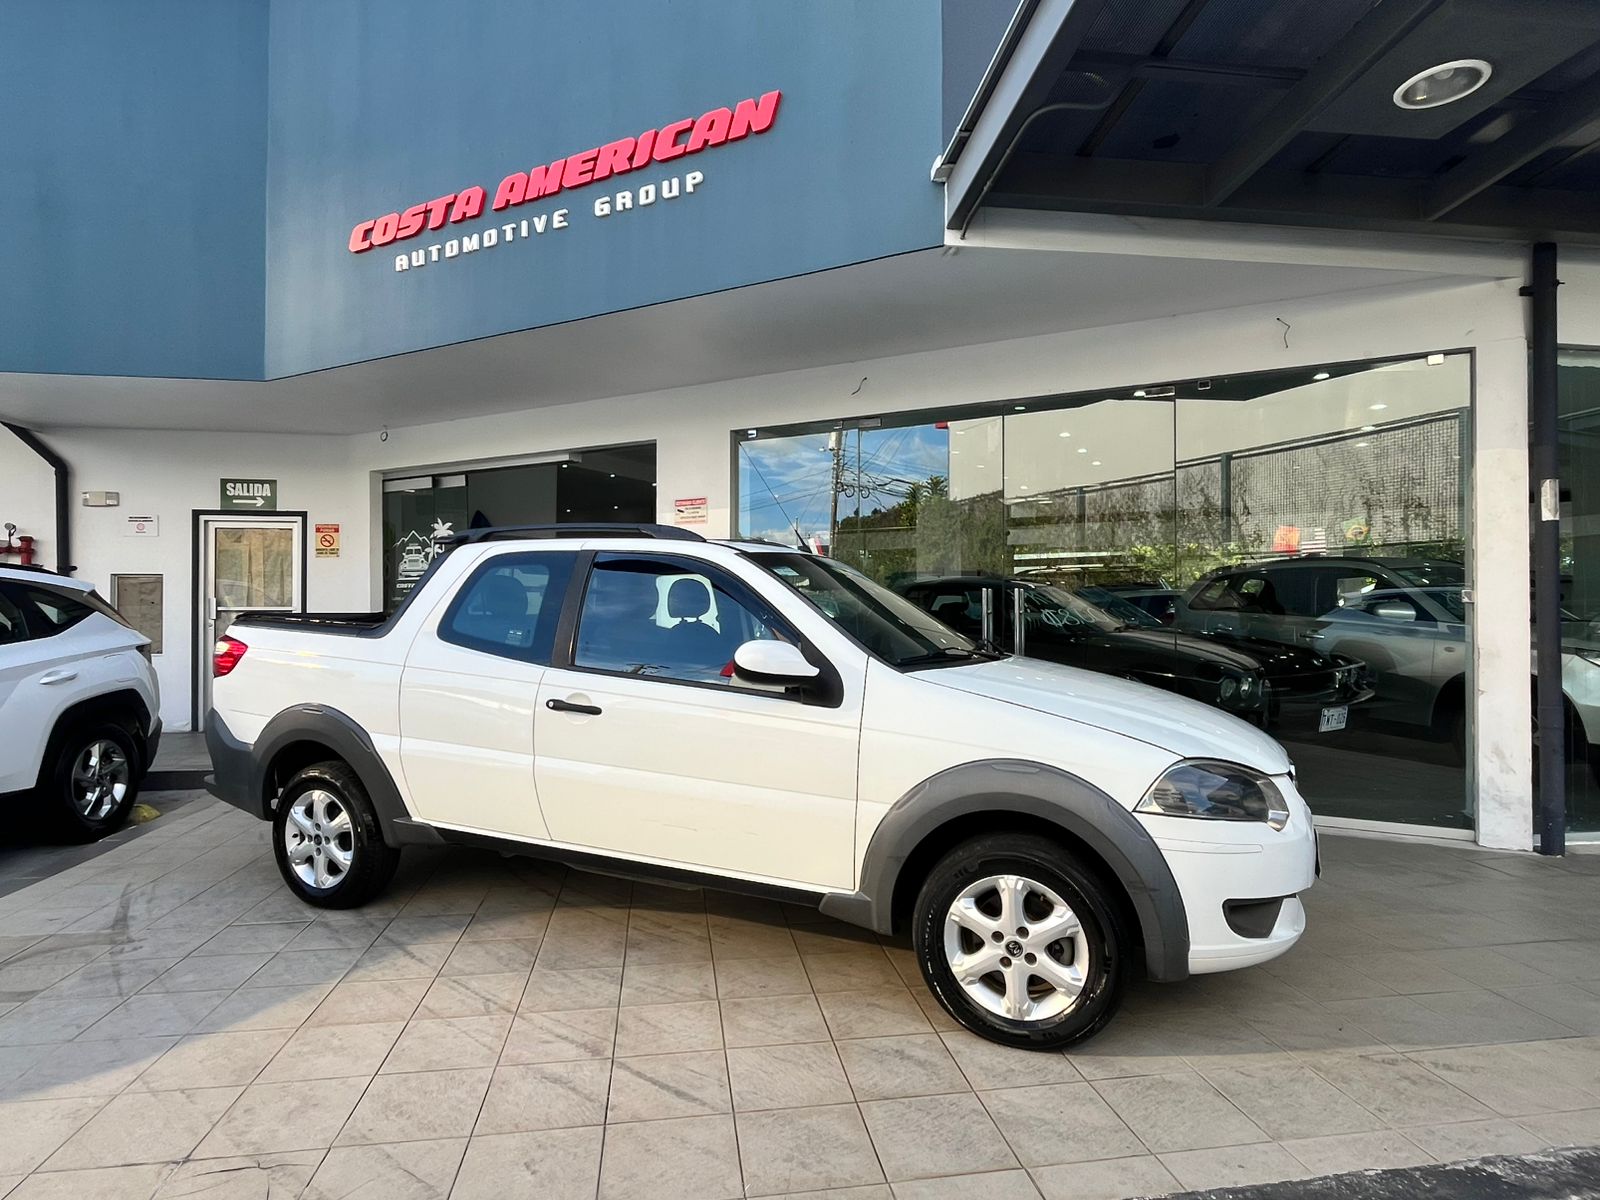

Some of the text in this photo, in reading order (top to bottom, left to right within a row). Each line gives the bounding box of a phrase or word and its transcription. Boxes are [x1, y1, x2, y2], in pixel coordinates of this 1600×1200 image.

[348, 89, 782, 254] COSTA AMERICAN
[395, 170, 704, 272] AUTOMOTIVE GROUP
[226, 482, 271, 496] SALIDA
